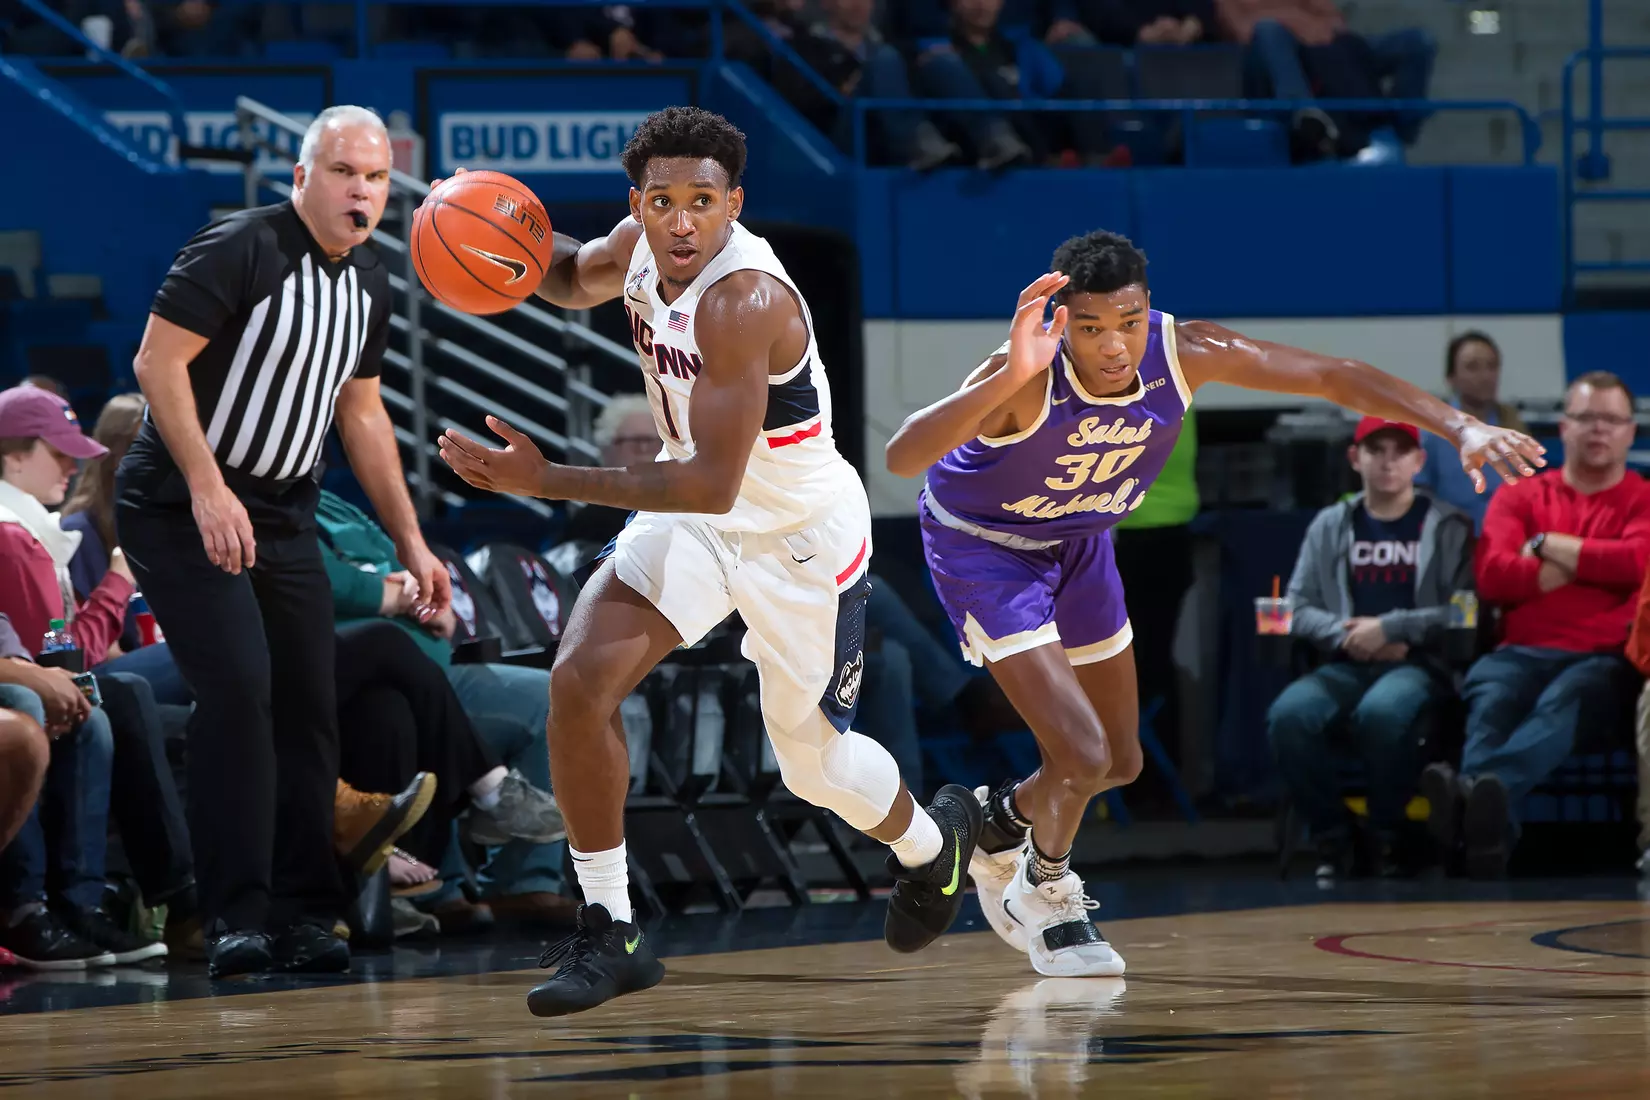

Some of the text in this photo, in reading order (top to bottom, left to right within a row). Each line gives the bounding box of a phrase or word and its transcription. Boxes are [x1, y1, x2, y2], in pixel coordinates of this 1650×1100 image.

[452, 124, 640, 162] BUD LIGH
[492, 196, 546, 245] ELITE
[624, 303, 703, 381] UCNN
[1067, 416, 1154, 447] Saint
[1044, 445, 1146, 491] 30
